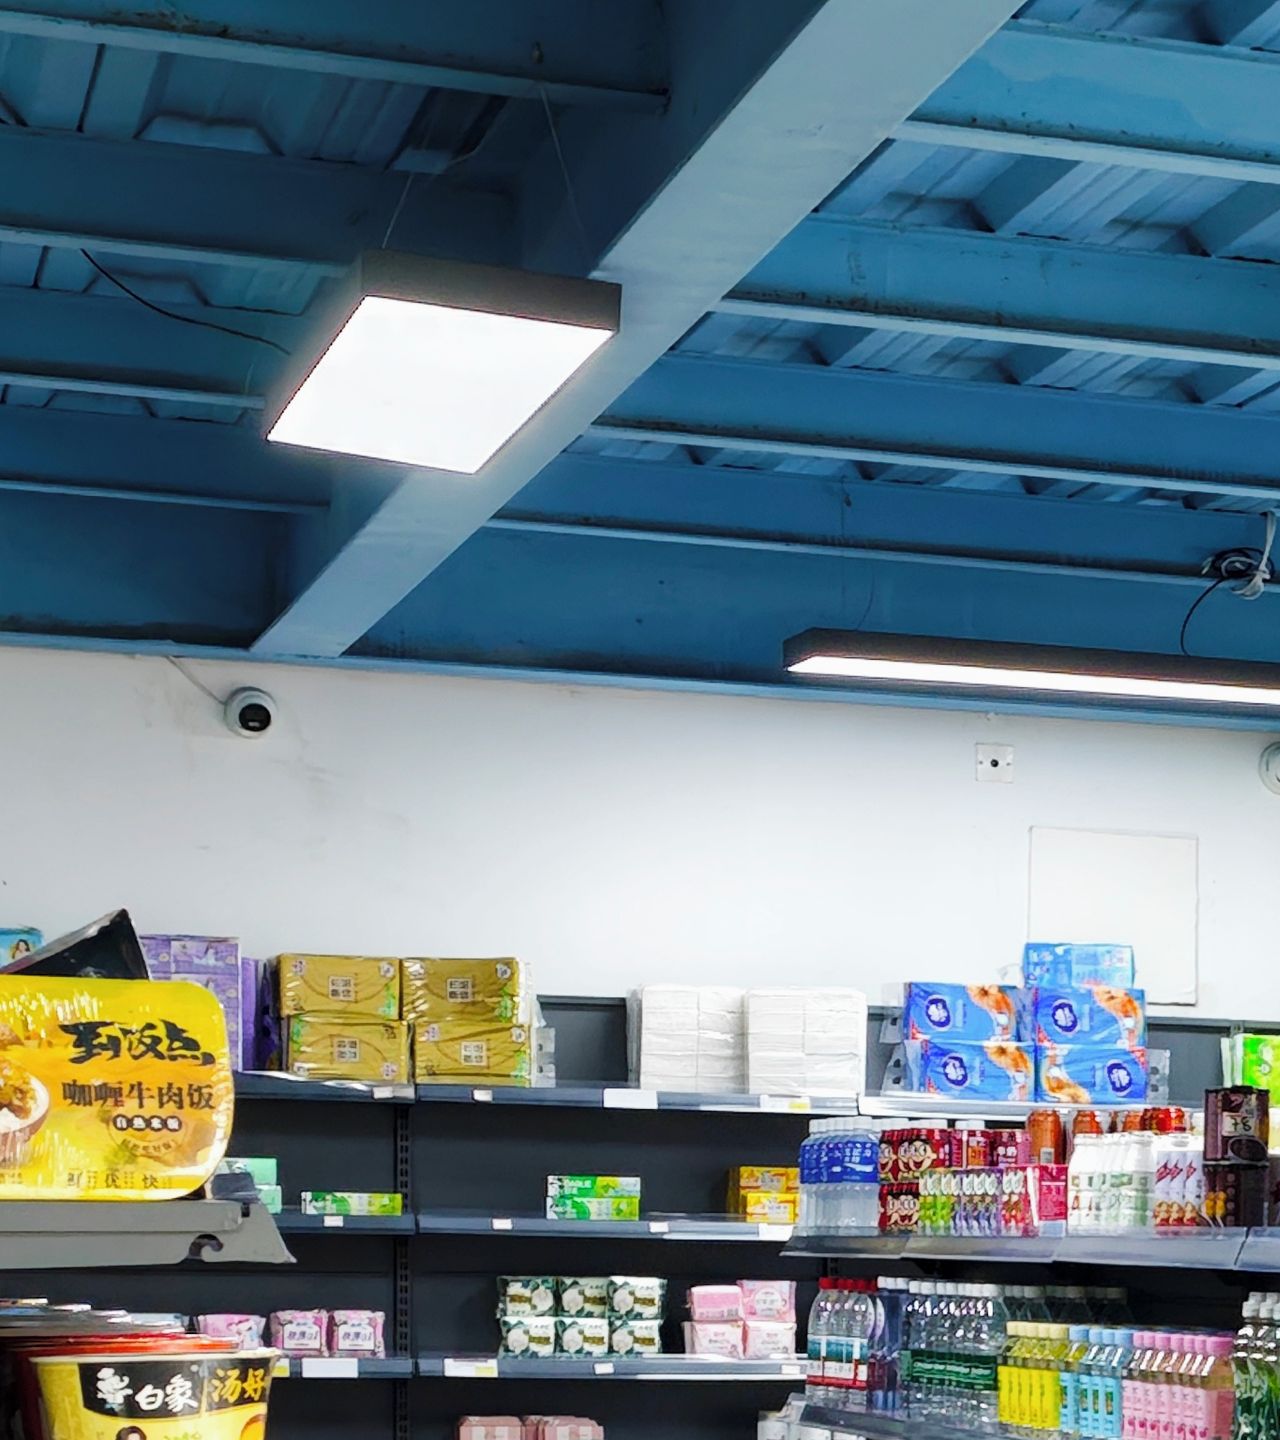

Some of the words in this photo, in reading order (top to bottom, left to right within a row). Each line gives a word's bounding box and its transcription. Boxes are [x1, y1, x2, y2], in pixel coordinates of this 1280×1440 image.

[61, 1079, 215, 1110] 咖喱牛肉饭
[212, 1367, 266, 1402] 汤好
